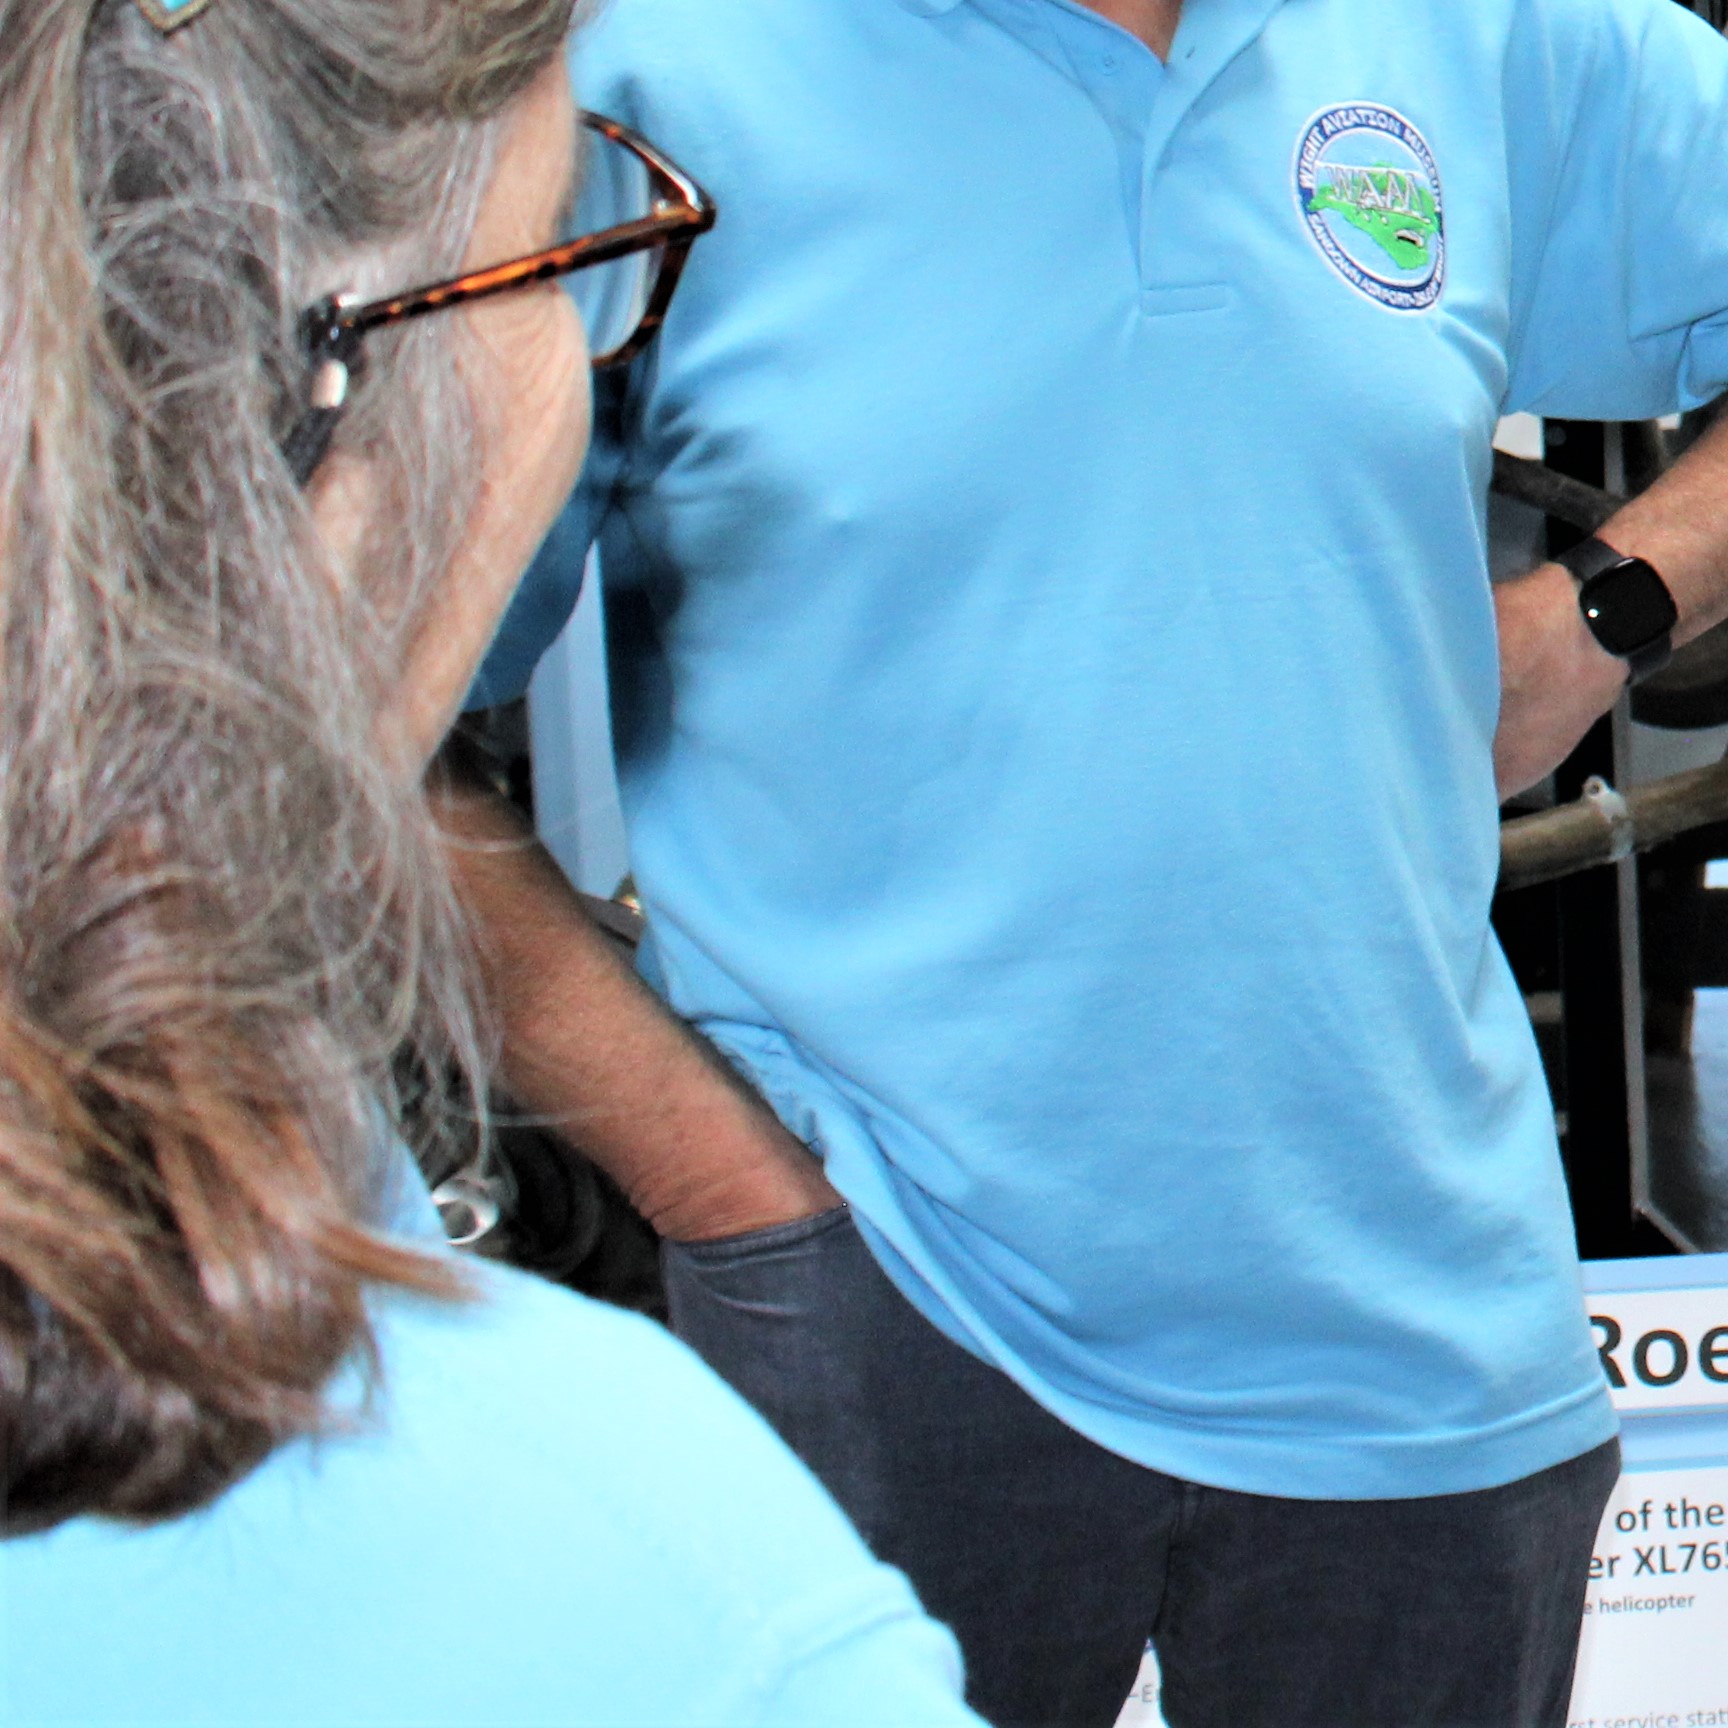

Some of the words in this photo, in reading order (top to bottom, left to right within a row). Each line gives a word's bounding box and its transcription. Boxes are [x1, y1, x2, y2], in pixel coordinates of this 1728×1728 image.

[1299, 125, 1325, 189] WIGHT
[1321, 108, 1401, 136] AVIATION
[1615, 1499, 1654, 1533] of
[1664, 1497, 1726, 1530] the
[1599, 1594, 1695, 1614] helicopter
[1603, 1712, 1679, 1728] service
